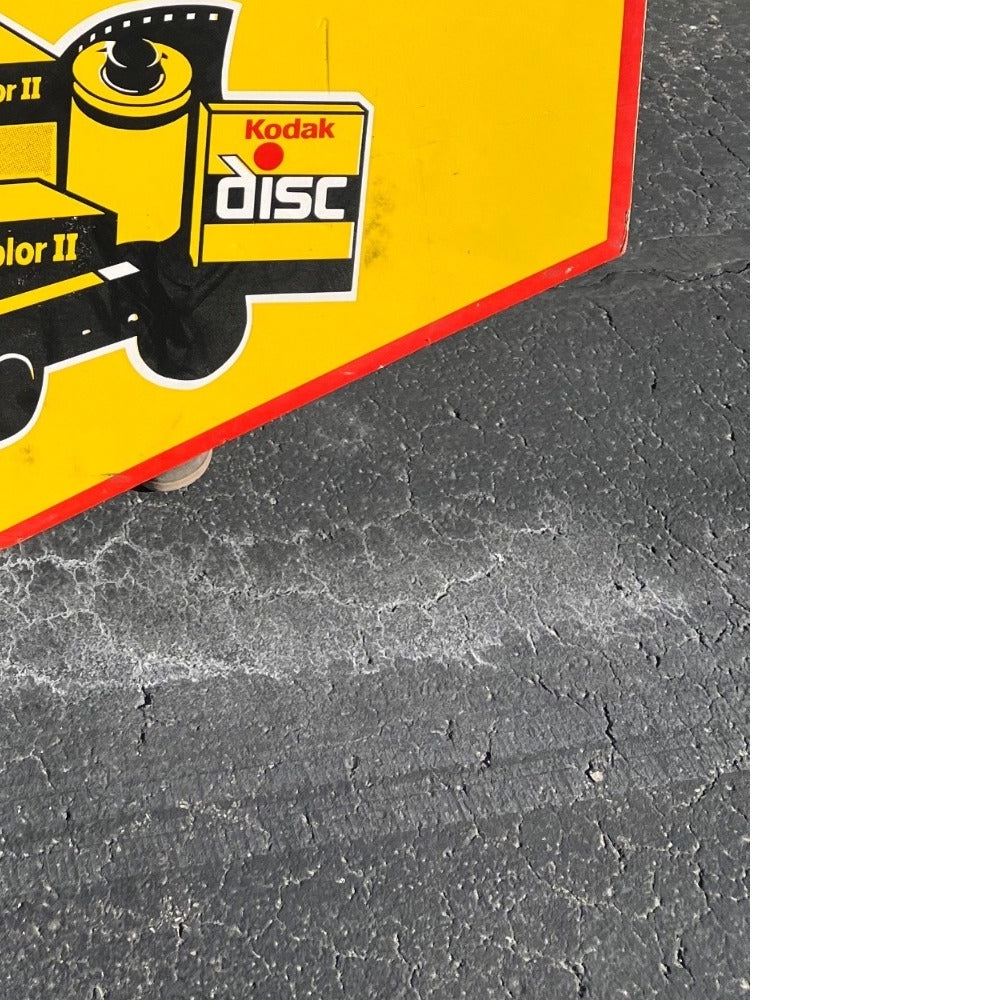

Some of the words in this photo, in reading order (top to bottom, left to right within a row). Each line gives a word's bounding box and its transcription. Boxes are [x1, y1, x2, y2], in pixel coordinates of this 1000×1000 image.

[20, 76, 42, 101] II
[245, 118, 335, 140] Kodak
[215, 155, 348, 220] disc
[52, 232, 79, 262] II
